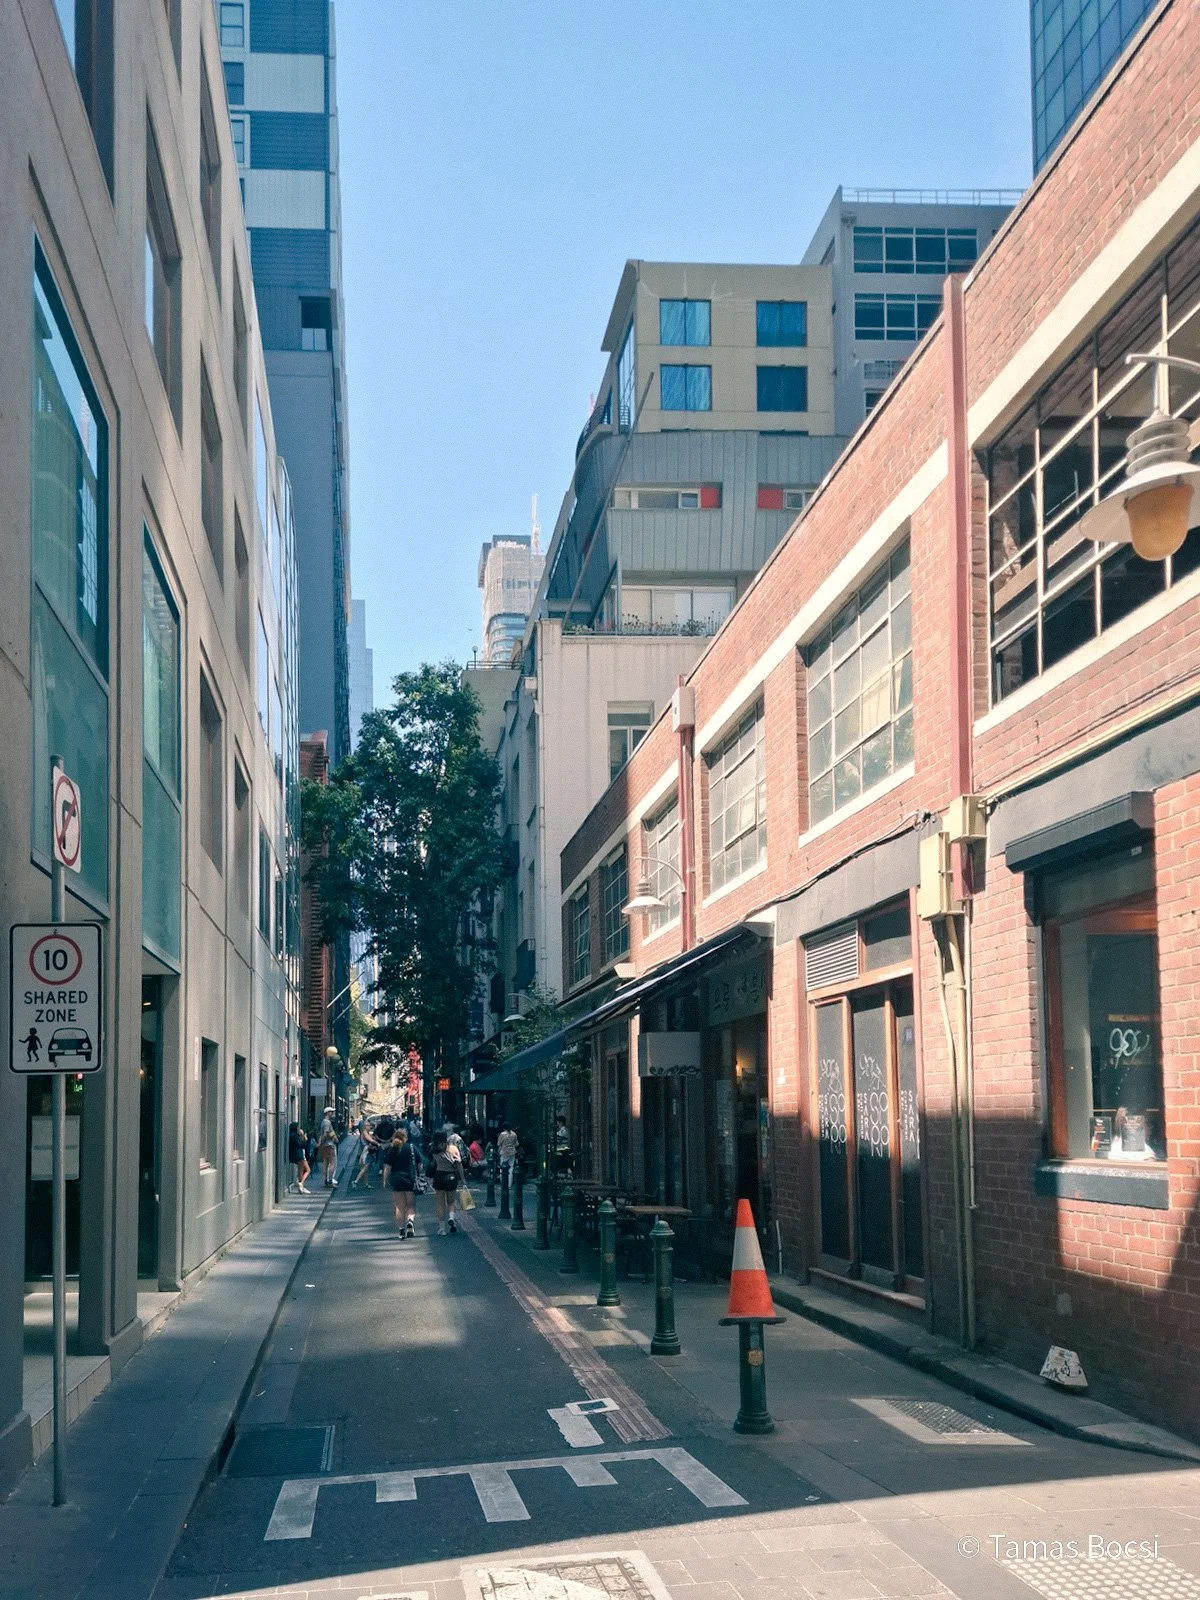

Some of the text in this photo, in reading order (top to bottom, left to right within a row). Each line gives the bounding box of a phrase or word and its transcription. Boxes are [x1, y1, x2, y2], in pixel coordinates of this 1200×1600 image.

[43, 949, 68, 971] 10
[24, 991, 88, 1005] SHARED
[35, 1009, 77, 1023] ZONE
